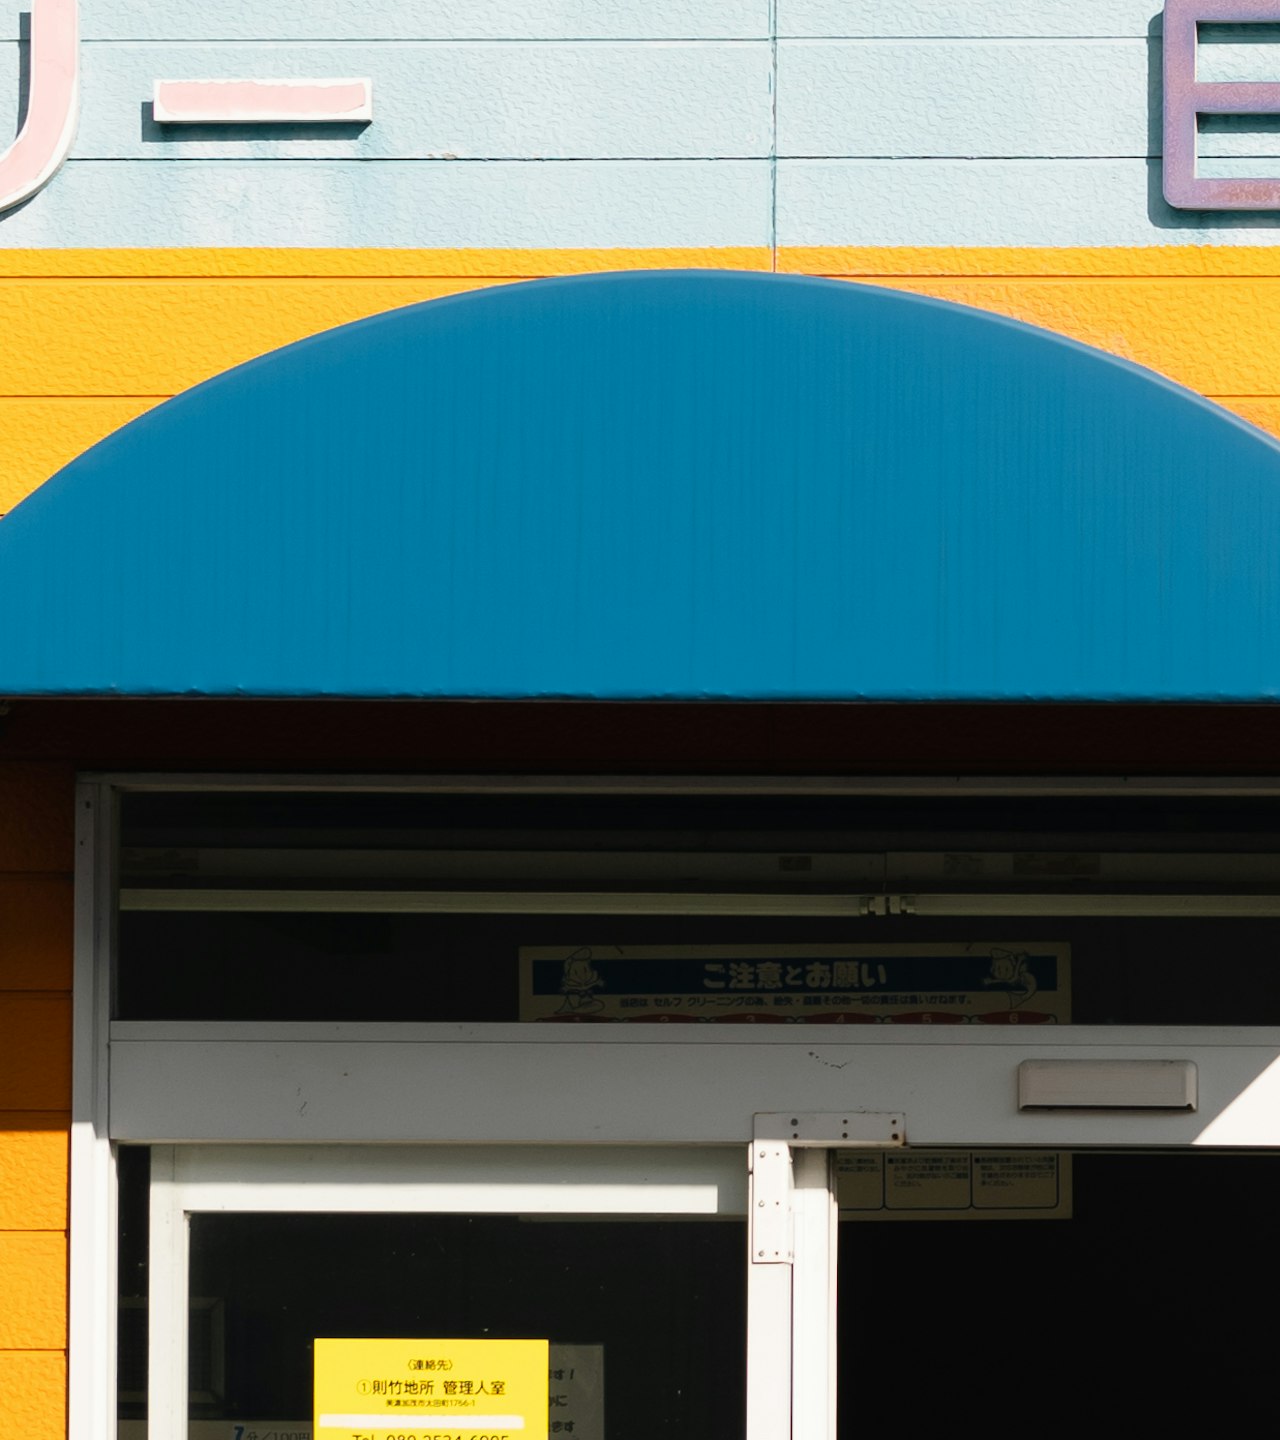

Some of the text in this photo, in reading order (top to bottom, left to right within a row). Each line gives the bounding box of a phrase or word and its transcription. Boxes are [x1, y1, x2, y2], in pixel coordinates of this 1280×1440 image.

[703, 959, 887, 989] ご注意とお願い
[443, 1380, 505, 1395] 管理人室
